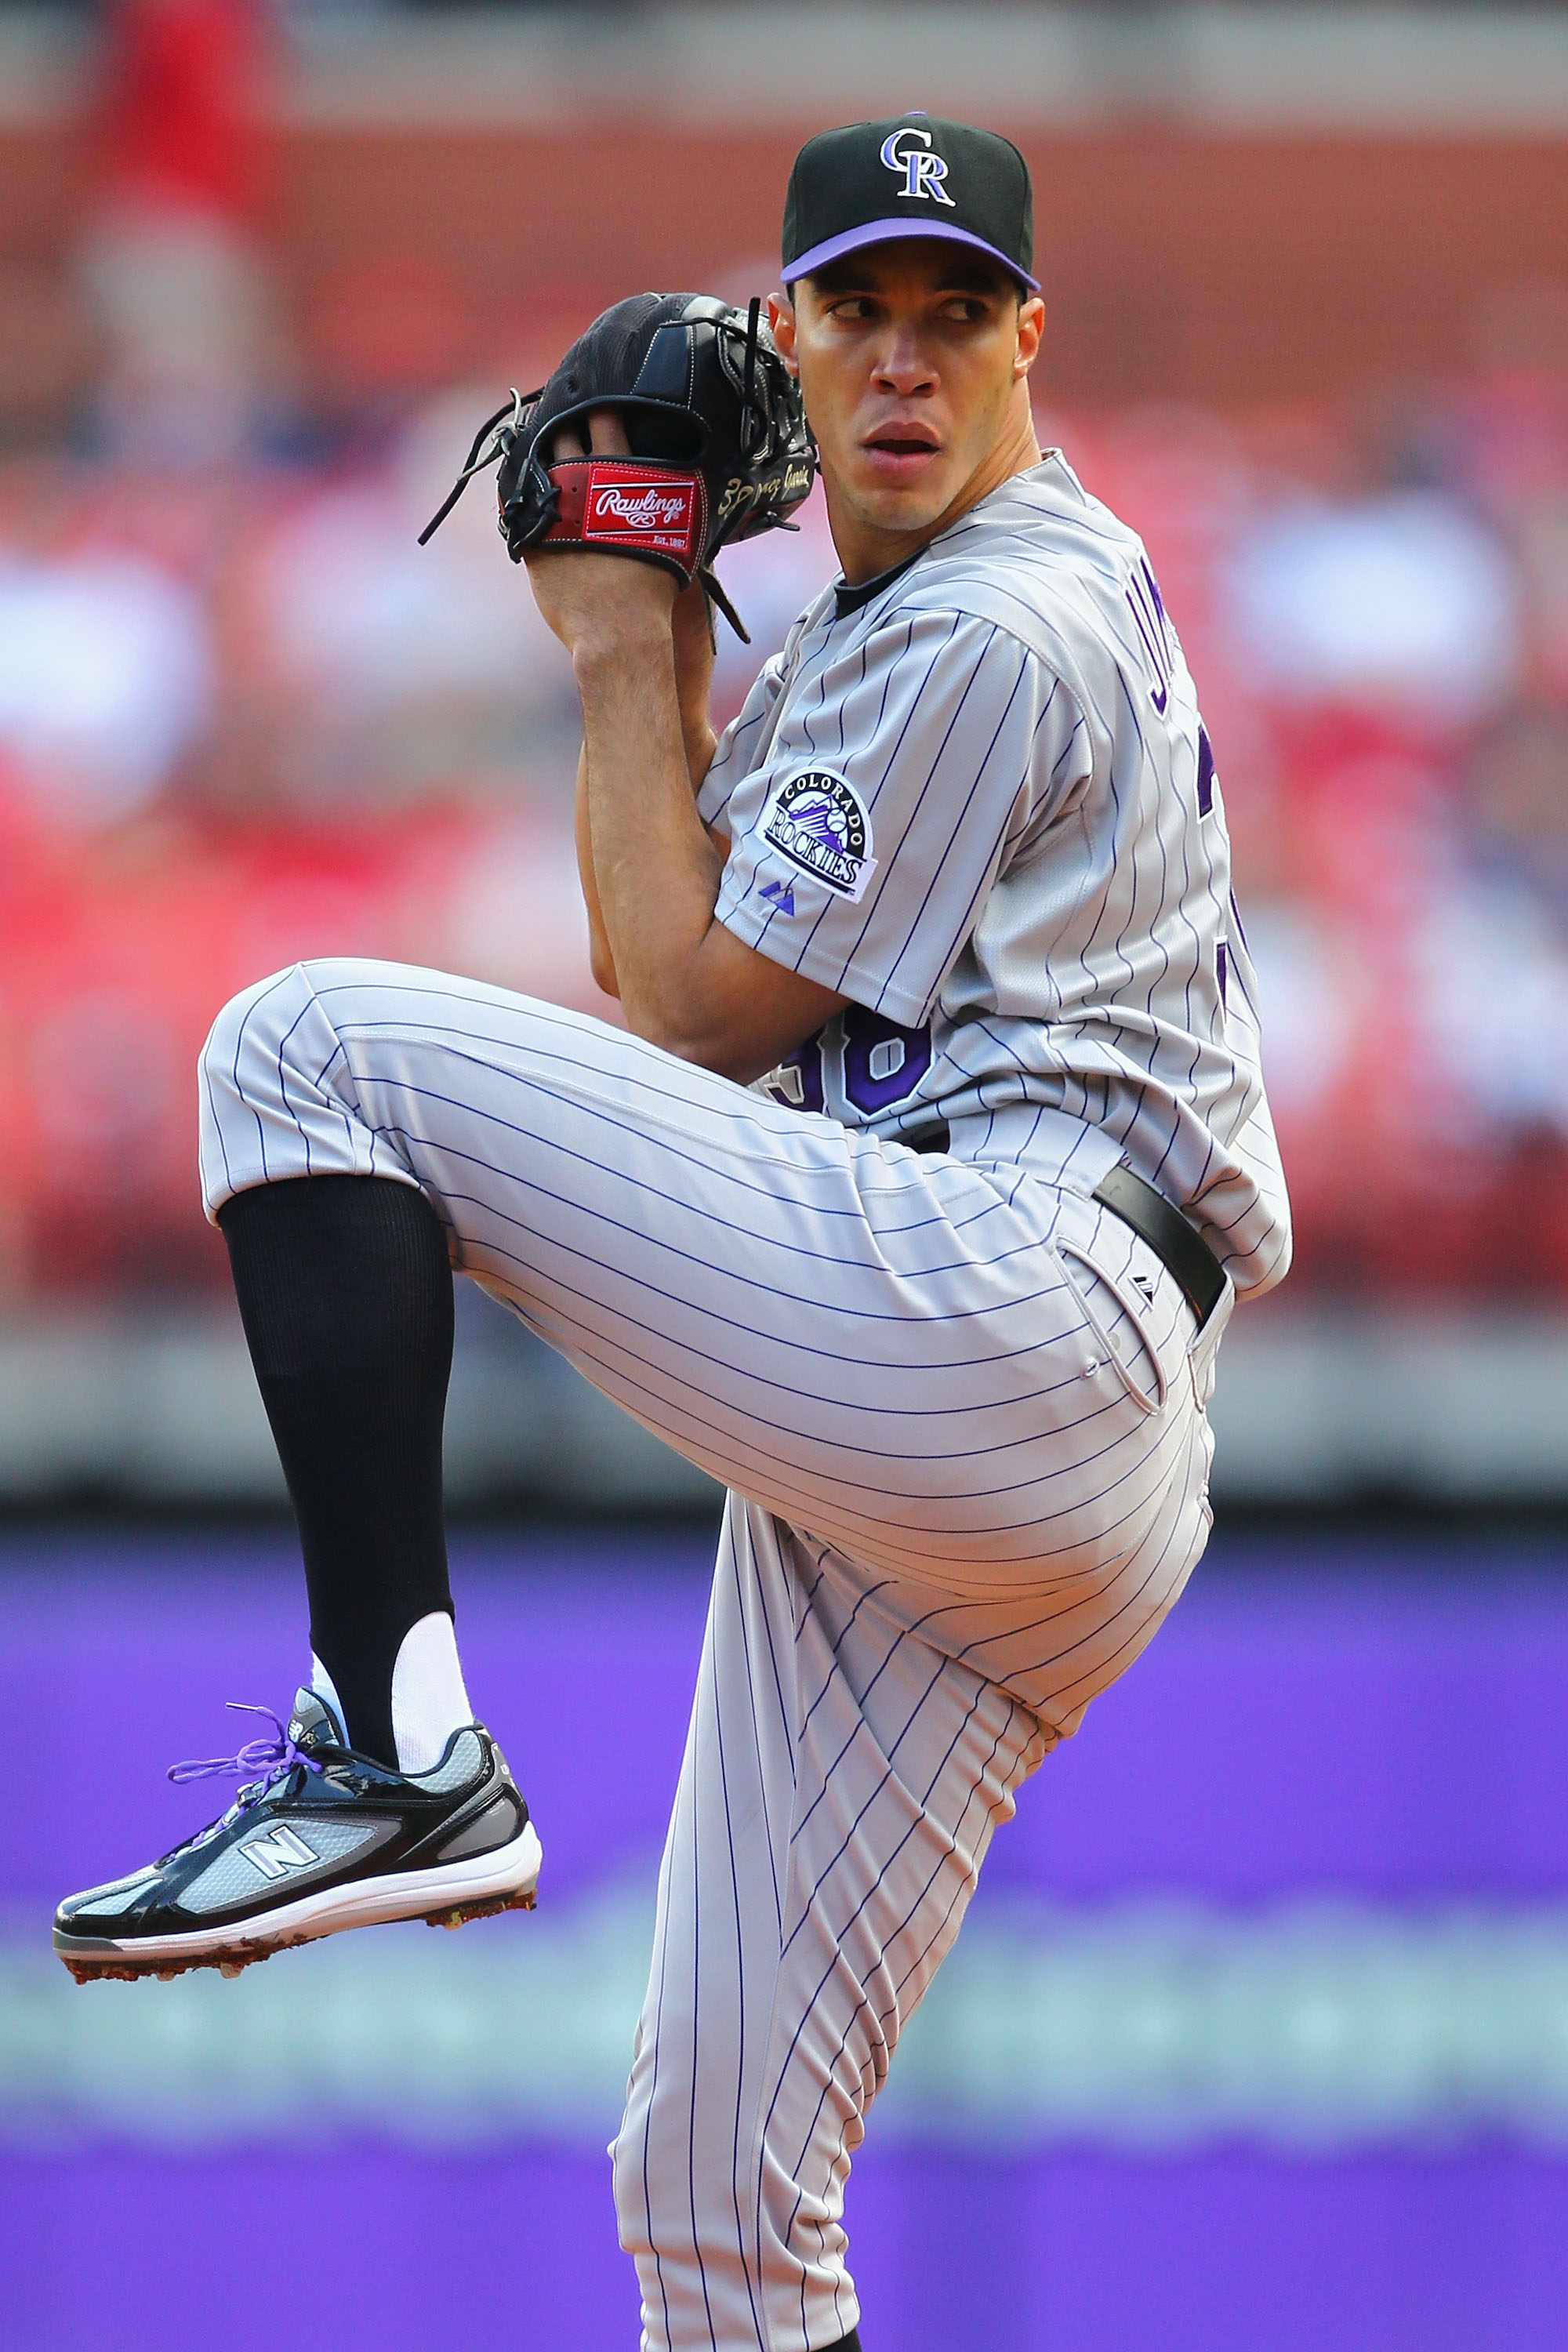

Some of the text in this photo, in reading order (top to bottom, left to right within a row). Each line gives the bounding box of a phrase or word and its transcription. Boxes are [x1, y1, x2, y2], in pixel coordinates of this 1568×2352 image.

[880, 128, 957, 207] CR
[596, 489, 686, 523] Rawlings
[768, 806, 864, 884] ROCKIES
[785, 775, 863, 847] COLORADO
[238, 1824, 320, 1881] N
